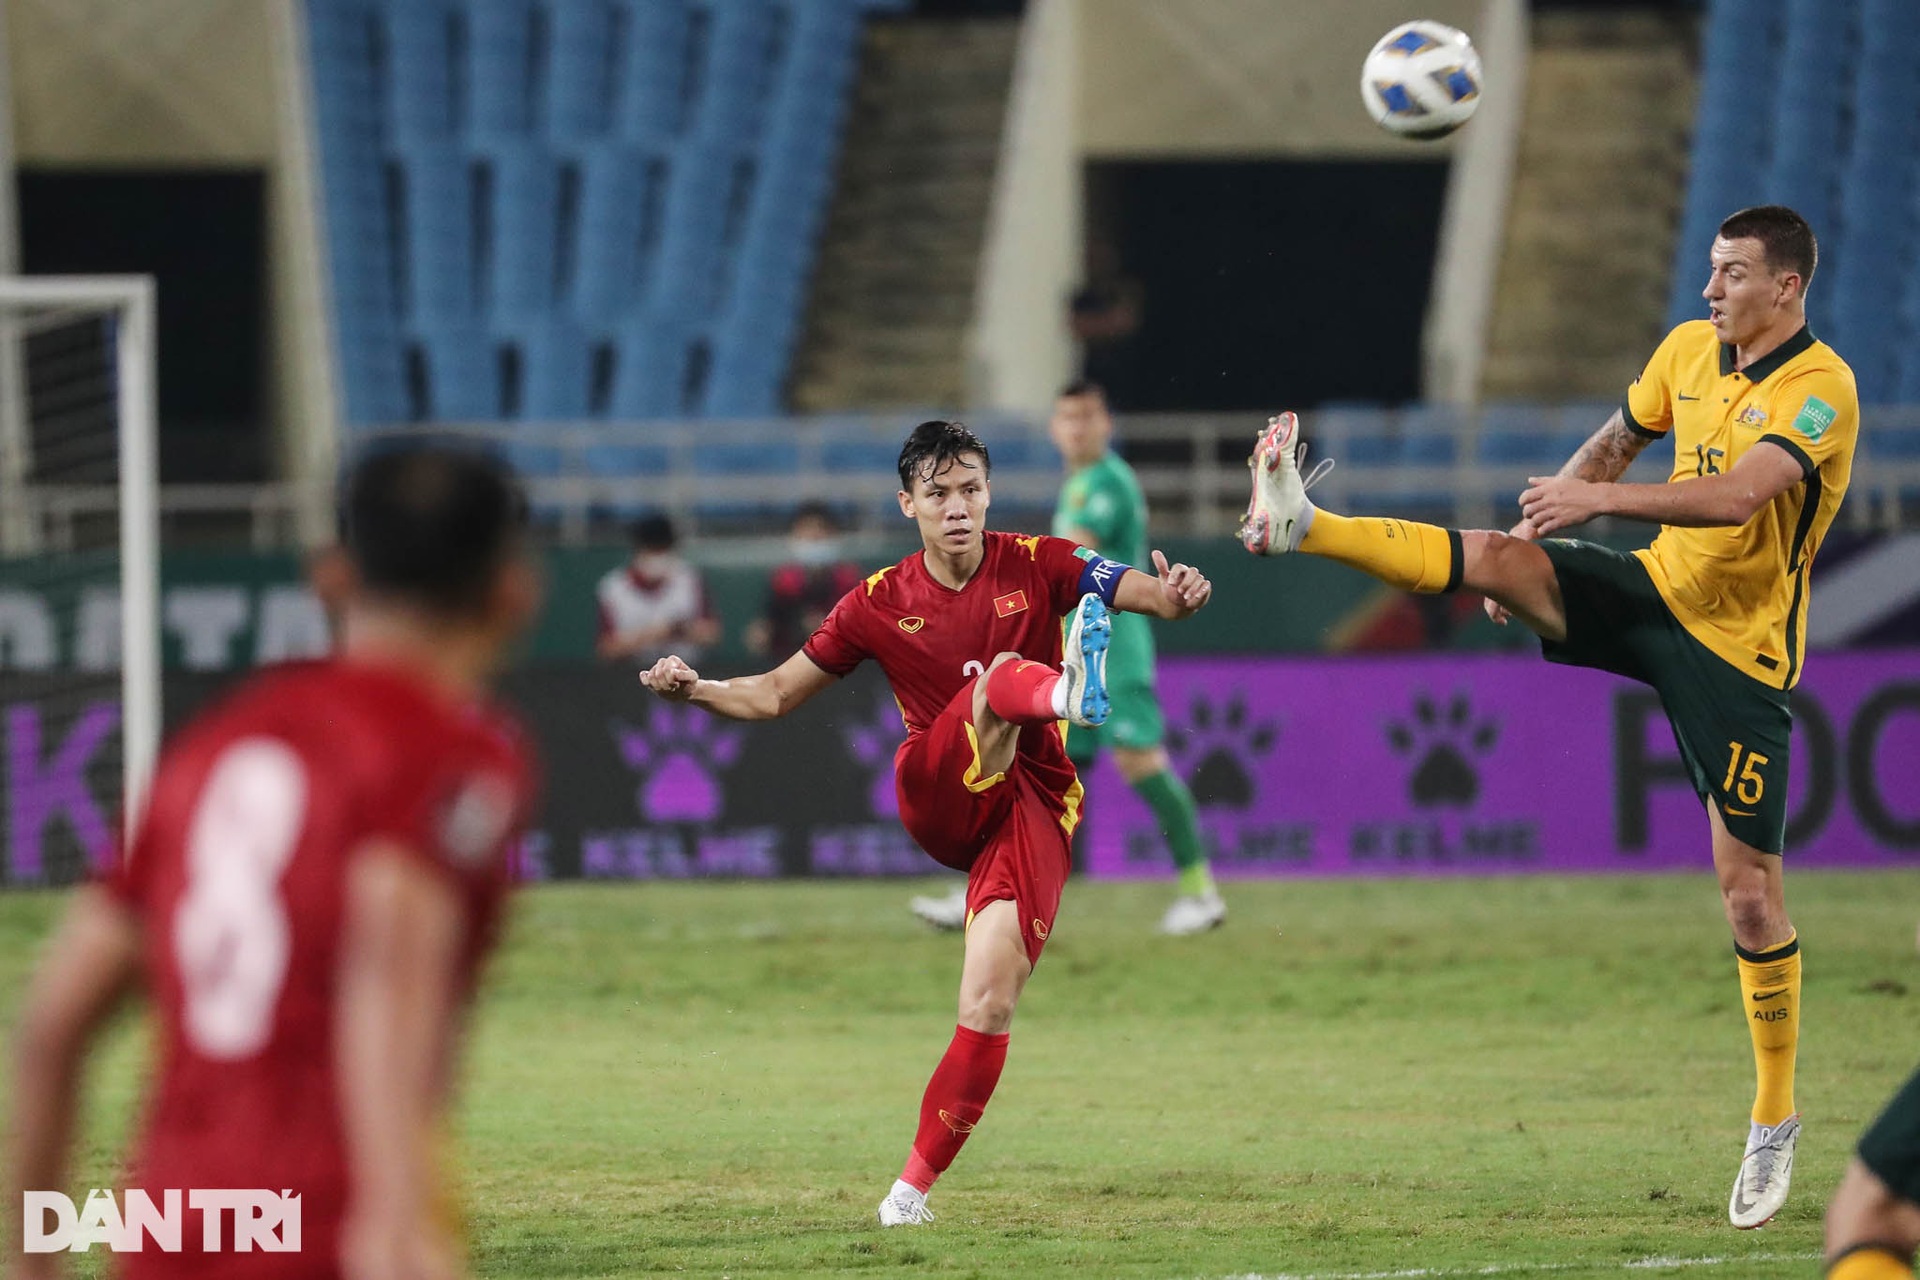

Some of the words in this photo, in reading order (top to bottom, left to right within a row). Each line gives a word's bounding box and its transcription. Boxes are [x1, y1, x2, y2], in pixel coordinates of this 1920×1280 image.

[1696, 444, 1725, 477] 15
[1723, 741, 1769, 805] 15
[1754, 1008, 1788, 1022] AUS
